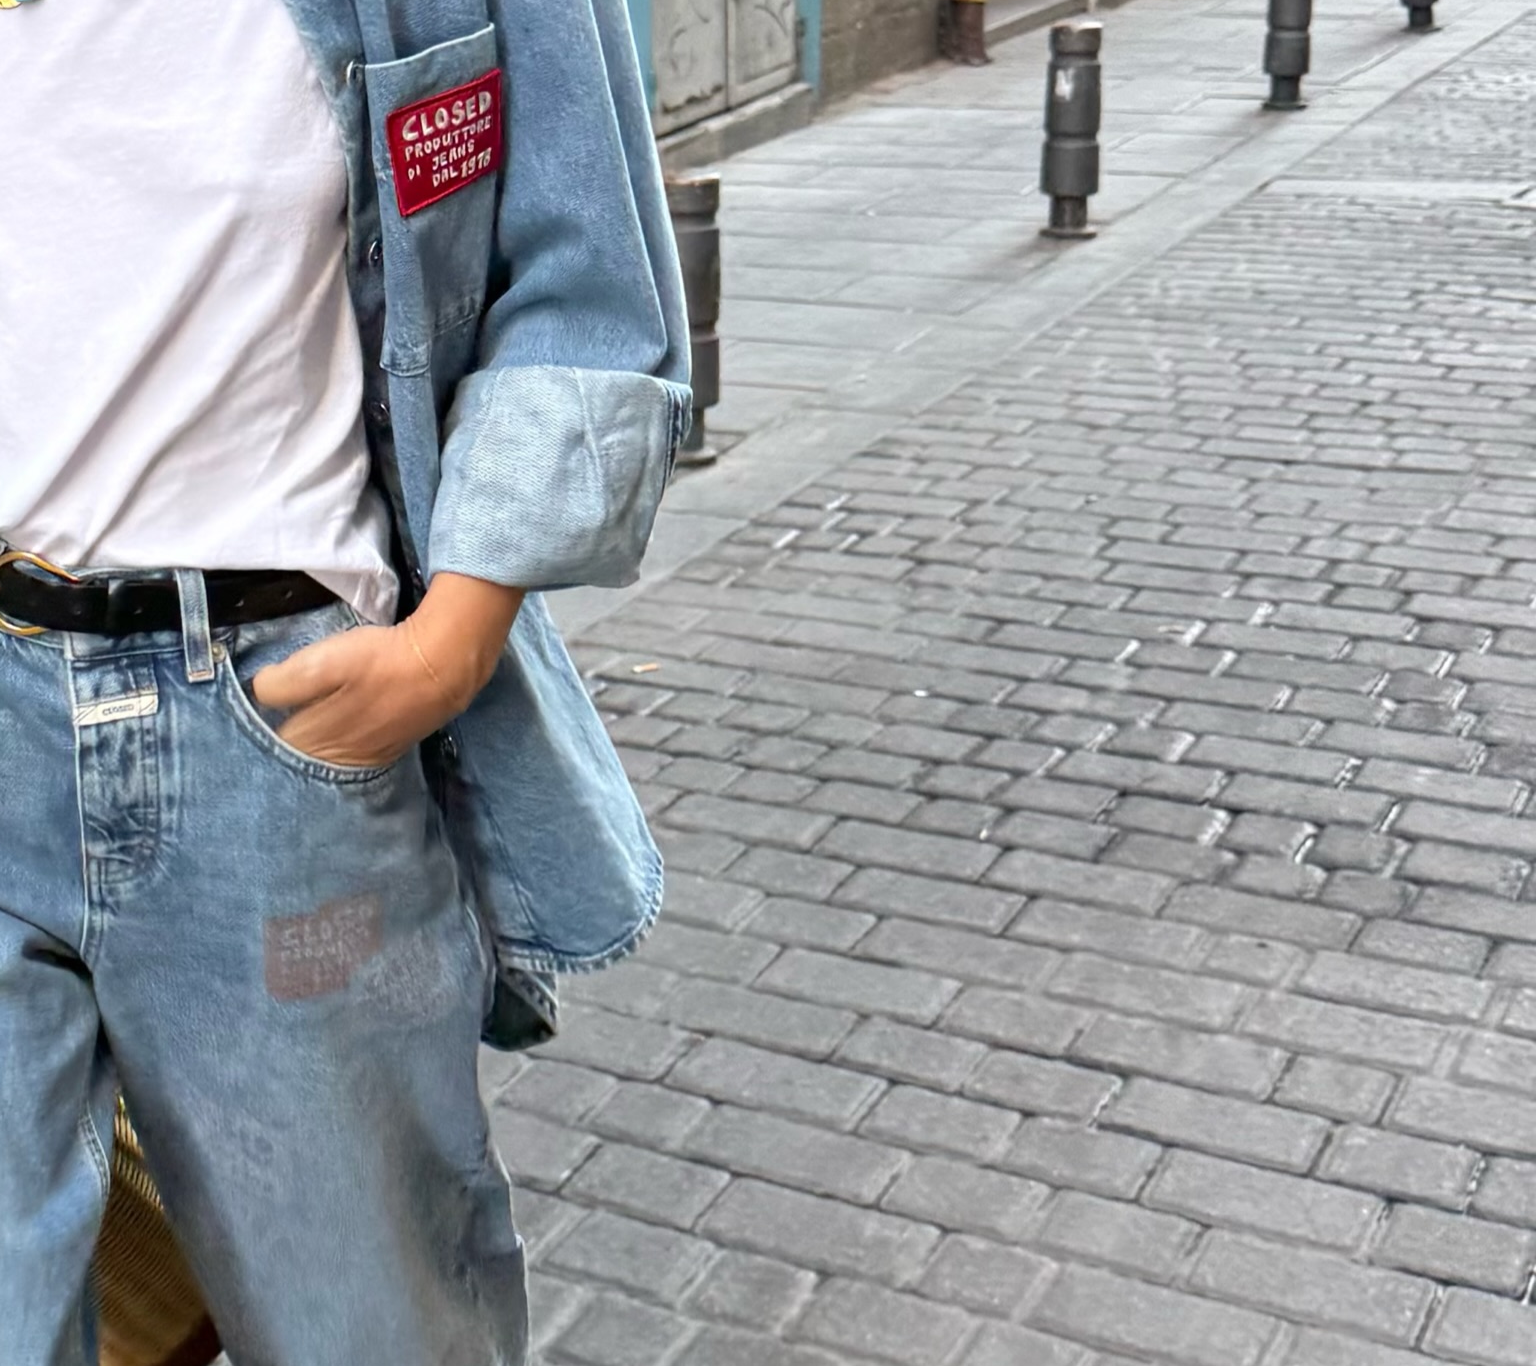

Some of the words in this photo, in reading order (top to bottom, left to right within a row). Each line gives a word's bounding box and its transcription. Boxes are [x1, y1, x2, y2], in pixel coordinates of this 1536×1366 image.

[402, 91, 492, 142] CLOSED
[405, 116, 492, 162] PRODUTTORE
[408, 164, 422, 181] DI
[432, 139, 475, 171] JEANS
[432, 165, 459, 188] DAL
[460, 147, 492, 179] 1978
